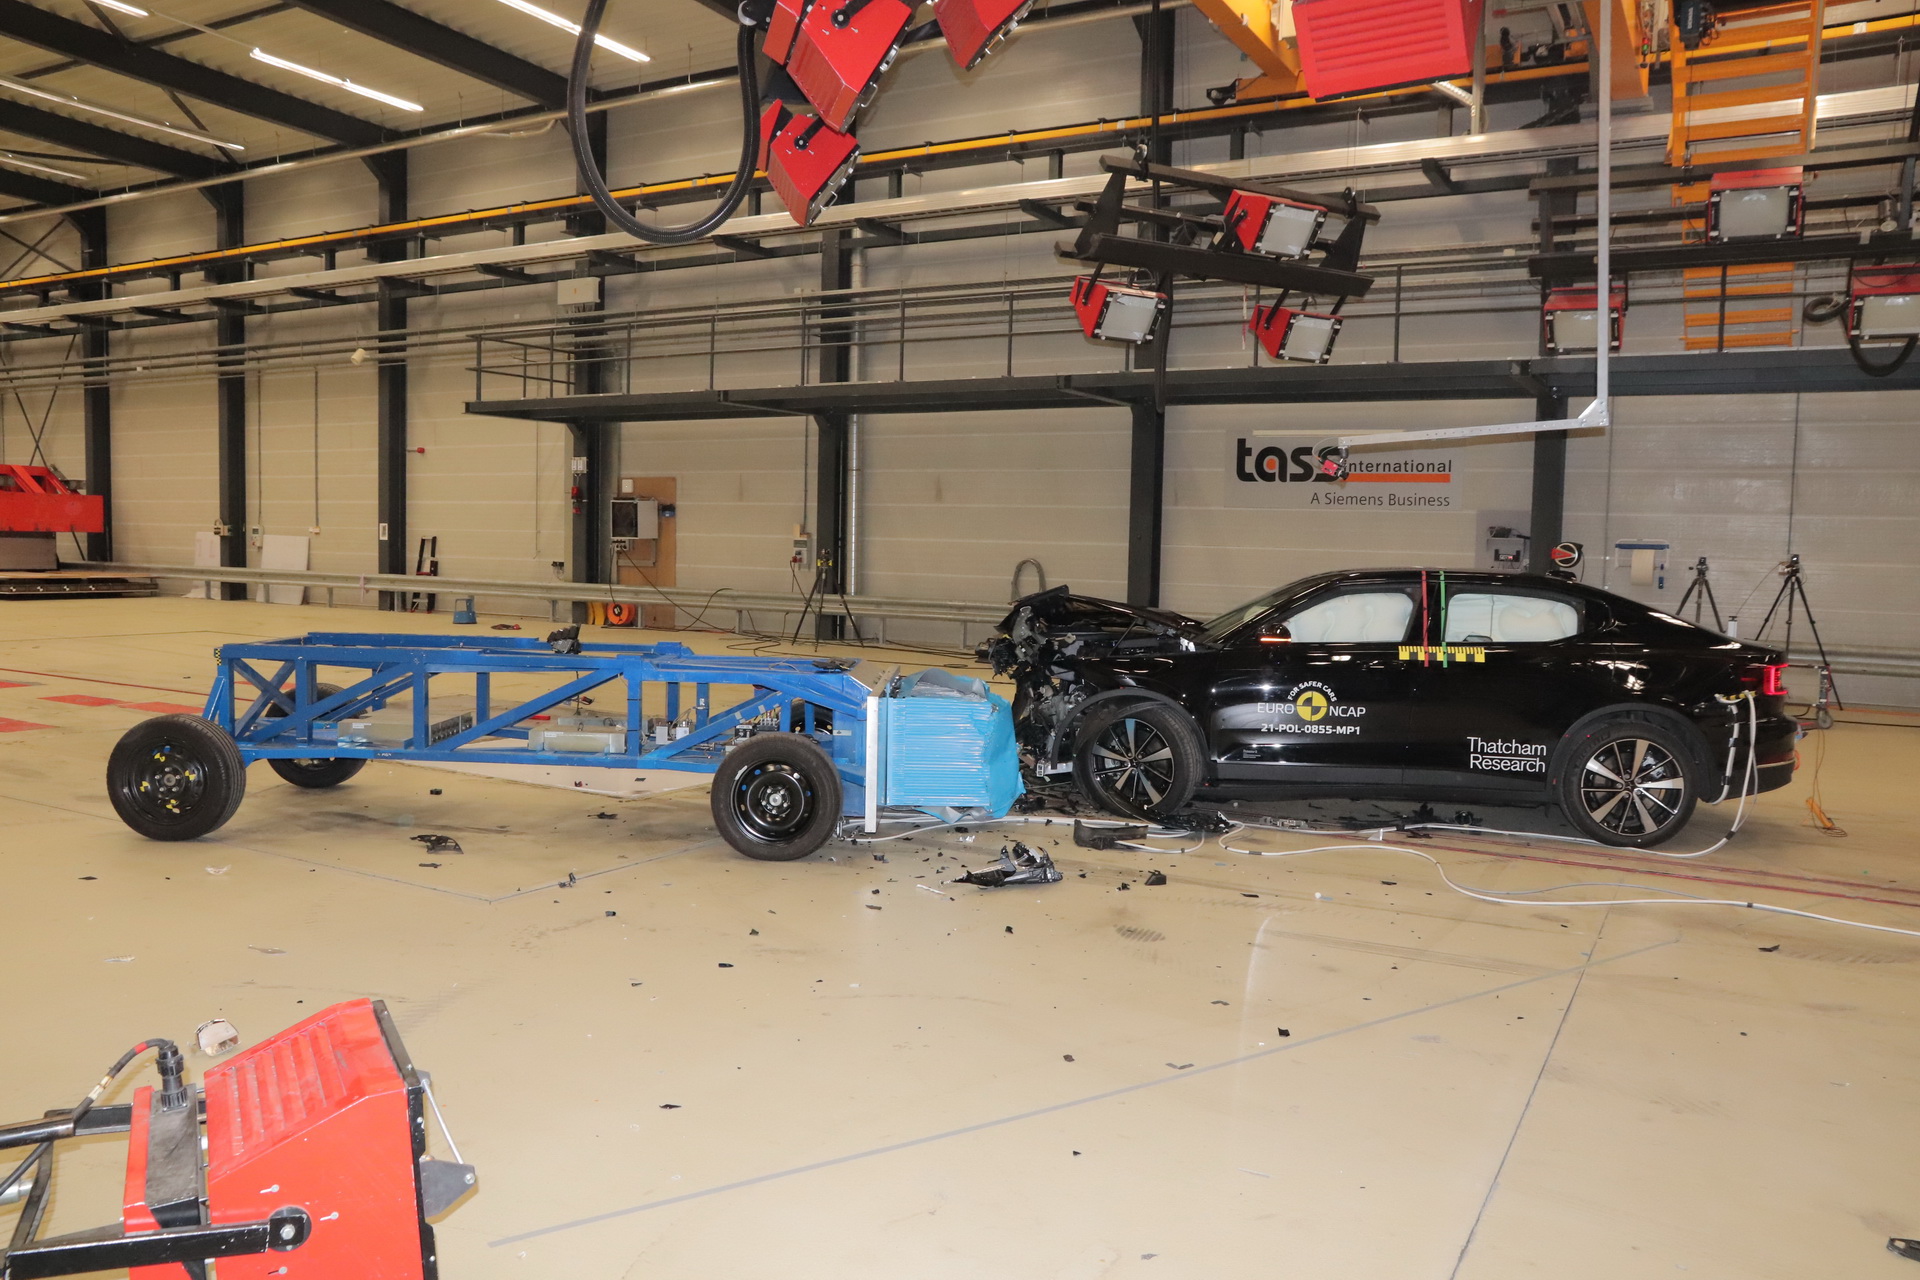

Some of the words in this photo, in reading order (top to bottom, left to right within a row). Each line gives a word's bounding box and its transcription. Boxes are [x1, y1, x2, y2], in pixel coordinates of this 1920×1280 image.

[1236, 438, 1344, 482] tass
[1310, 492, 1320, 505] A
[1324, 491, 1383, 506] Siemens
[1388, 492, 1450, 507] Business
[1287, 686, 1300, 701] FOR
[1298, 680, 1323, 690] SAFER
[1322, 685, 1338, 702] CARS
[1257, 702, 1295, 714] EURO
[1329, 705, 1366, 718] NCAP
[1260, 723, 1361, 735] 21-POL-0855-MP1
[1466, 736, 1547, 756] Thatcham
[1470, 753, 1546, 773] Research
